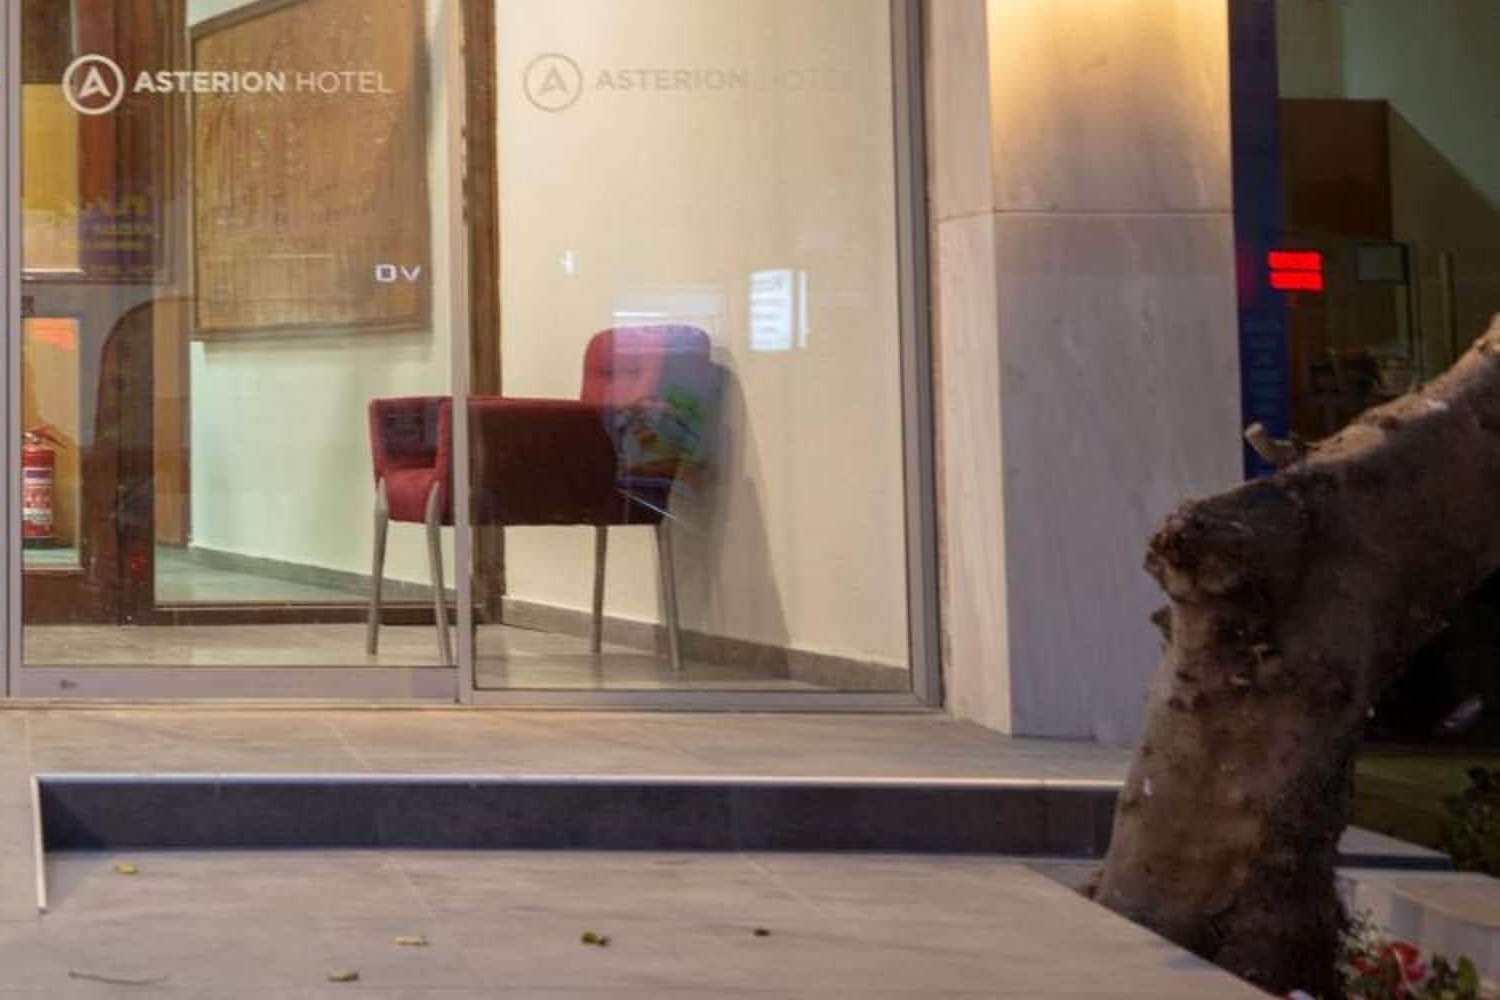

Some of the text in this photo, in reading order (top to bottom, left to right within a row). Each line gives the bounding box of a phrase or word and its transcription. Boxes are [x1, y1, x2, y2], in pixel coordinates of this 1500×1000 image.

[133, 71, 285, 93] ASTERION
[296, 71, 393, 93] HOTEL
[596, 69, 749, 90] ASTERION
